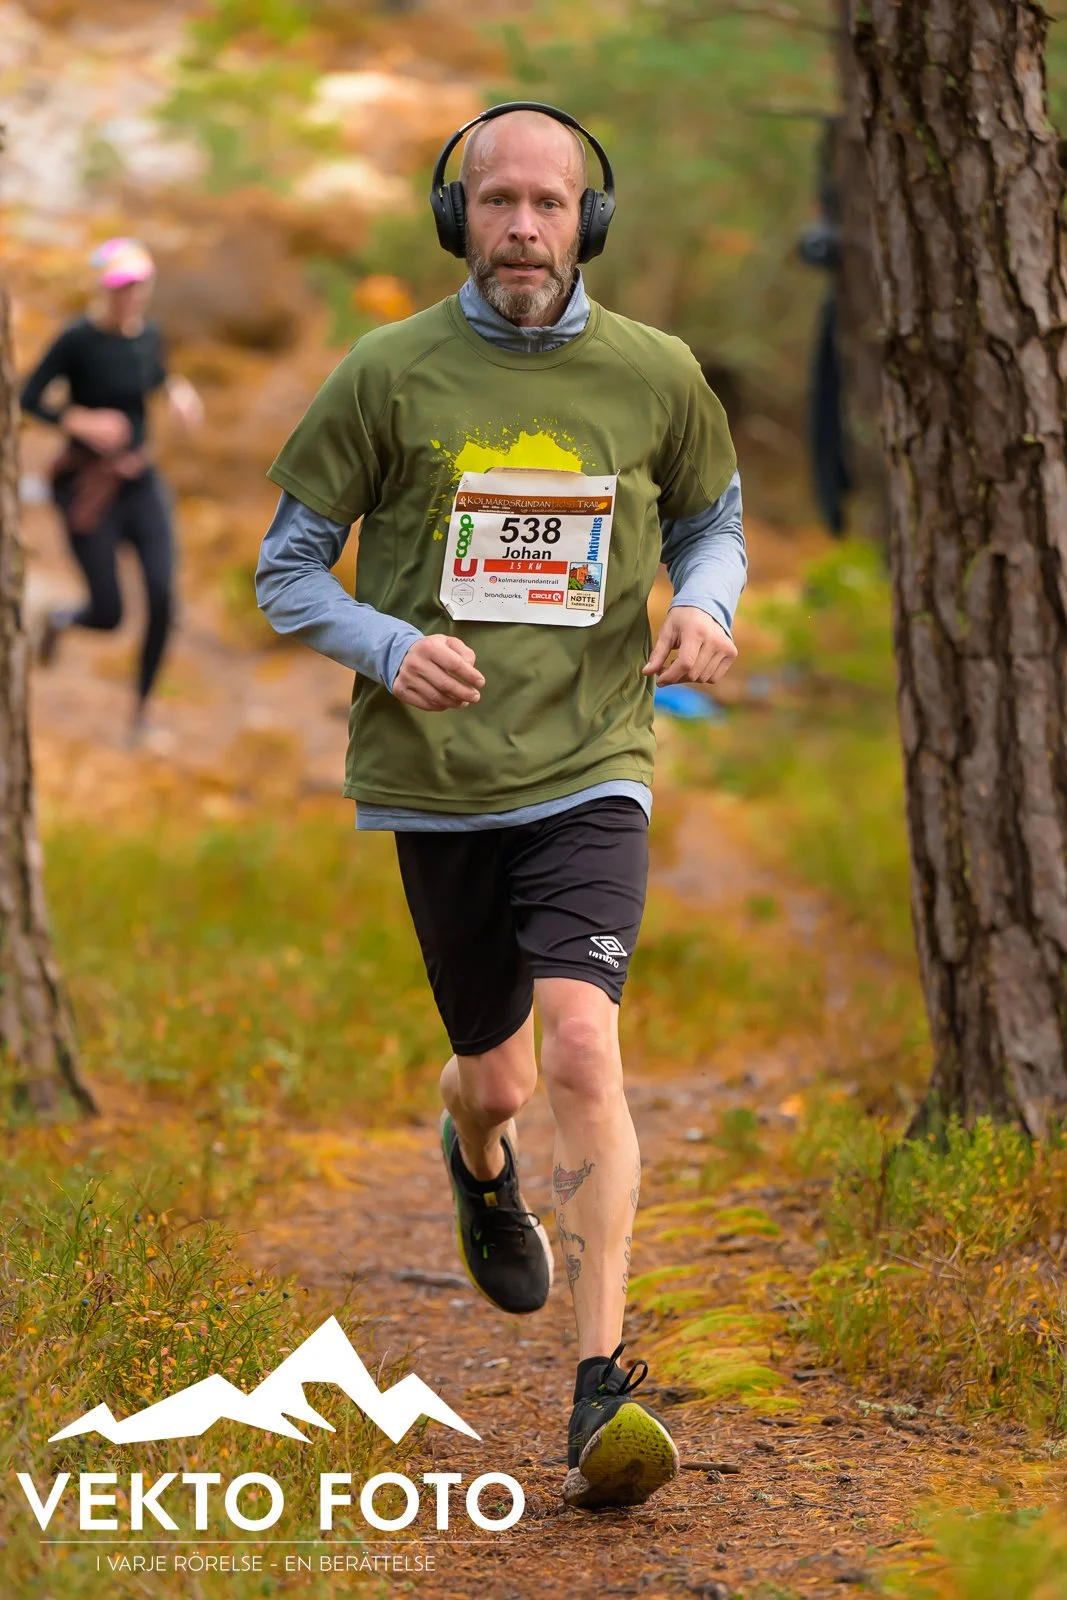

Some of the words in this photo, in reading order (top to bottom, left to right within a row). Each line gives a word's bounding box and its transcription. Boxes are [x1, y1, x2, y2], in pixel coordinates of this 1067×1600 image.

[456, 514, 475, 559] coop
[499, 517, 562, 545] 538
[586, 516, 603, 562] Aktivitus
[502, 547, 552, 560] Johan
[509, 561, 522, 570] 15
[528, 561, 543, 570] KM
[531, 592, 551, 600] CIRCLE
[553, 592, 561, 601] K
